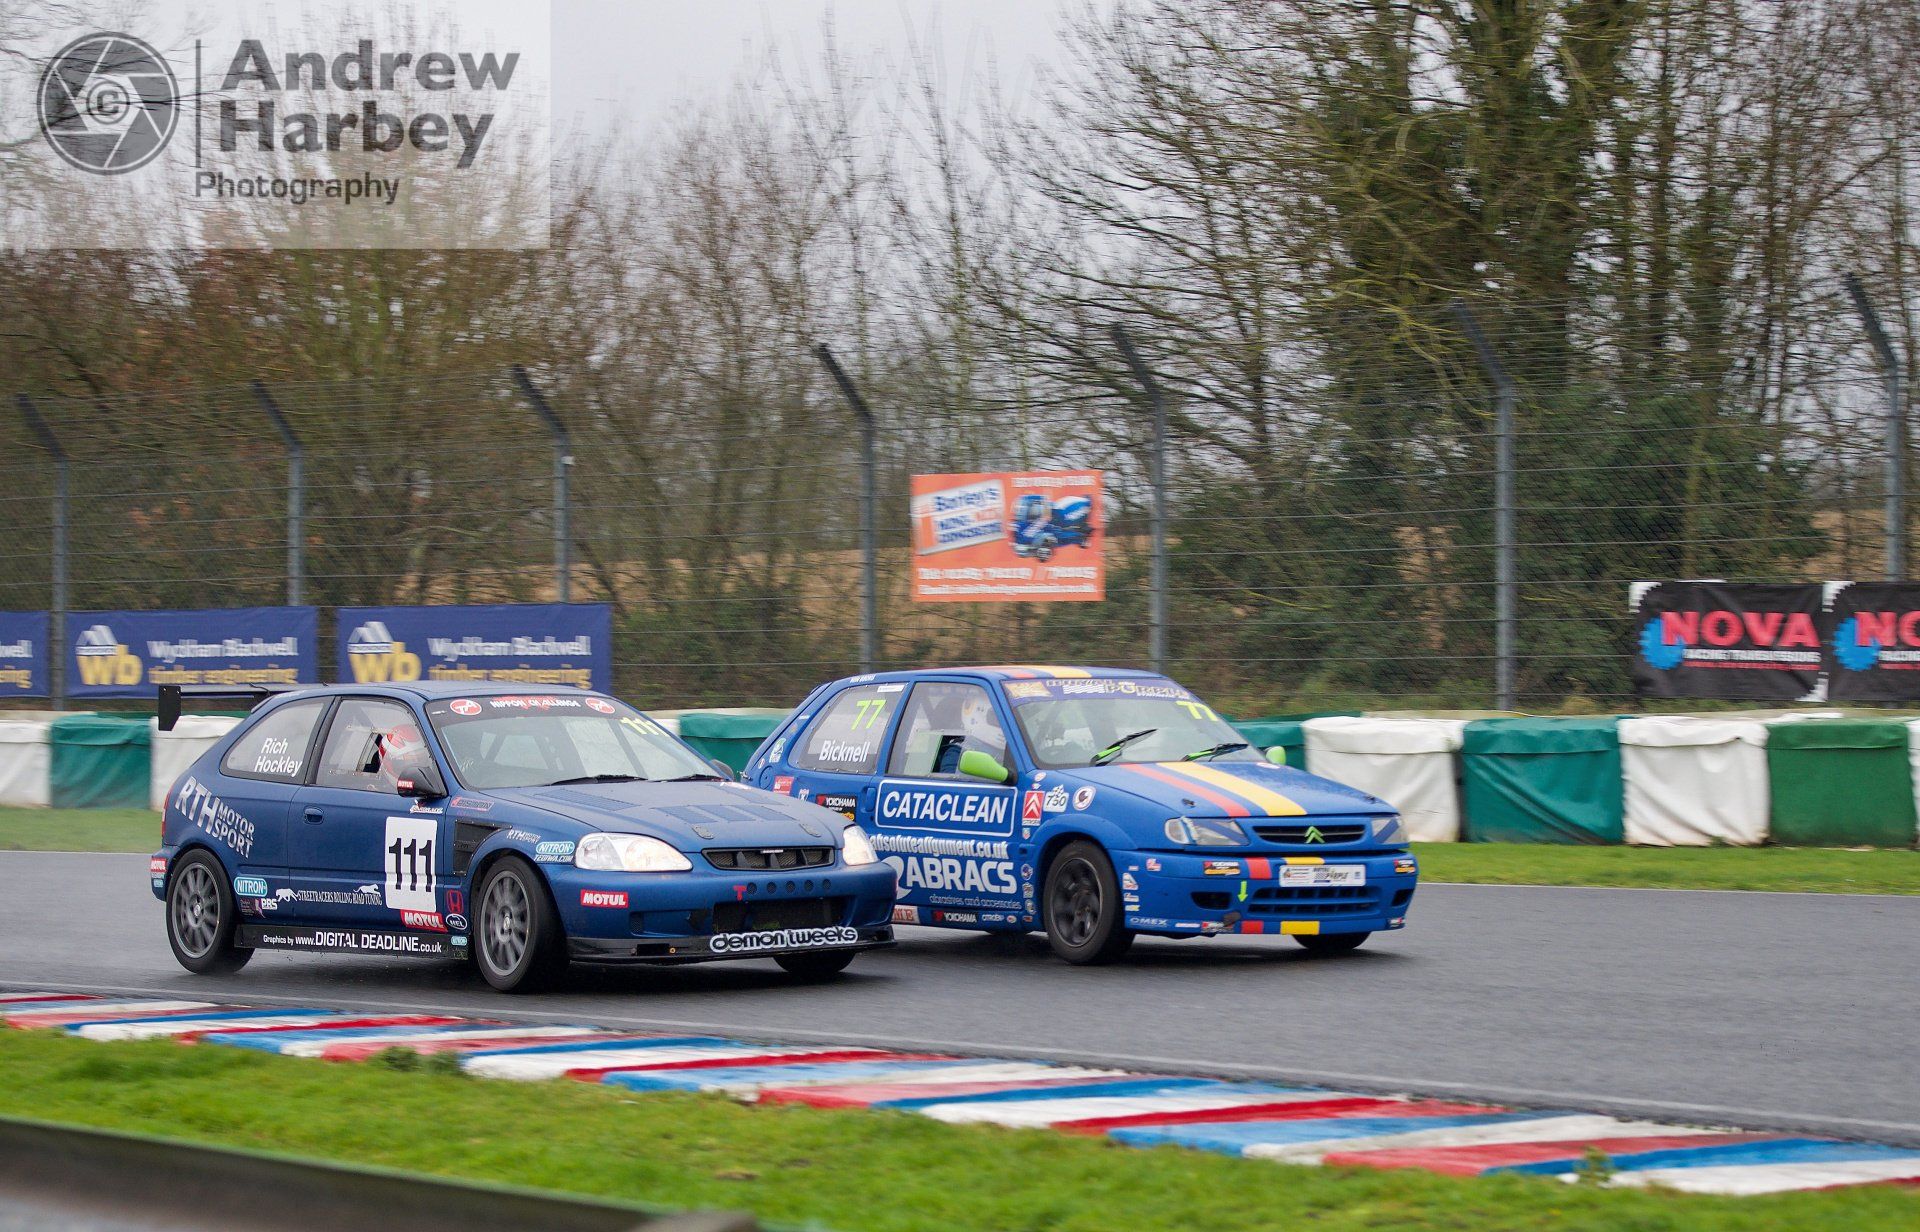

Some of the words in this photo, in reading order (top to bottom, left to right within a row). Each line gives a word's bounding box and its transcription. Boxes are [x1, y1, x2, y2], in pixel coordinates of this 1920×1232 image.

[1660, 610, 1821, 647] NOVA
[490, 699, 527, 708] NIPPON
[1175, 700, 1219, 721] 77
[851, 699, 887, 730] 77
[620, 717, 670, 737] 111
[261, 737, 288, 755] Rich
[818, 740, 870, 763] Bicknell
[254, 755, 303, 778] Hockley
[175, 775, 220, 834] RTH
[826, 797, 856, 807] YOKOHAMA
[883, 791, 1009, 824] CATACLEAN
[217, 802, 255, 841] MOTOR
[211, 818, 253, 859] SPORT
[539, 842, 571, 853] NITRON
[388, 838, 432, 893] 111
[907, 856, 1017, 895] ABRACS
[237, 879, 265, 894] NITRON
[583, 892, 626, 906] MOTUL
[964, 896, 980, 906] and
[404, 912, 444, 928] MOTUL
[944, 912, 977, 923] YOKOHAMA
[1130, 917, 1168, 926] OMEX
[263, 934, 287, 945] Graphics
[287, 936, 294, 946] by
[710, 931, 785, 952] demon
[786, 926, 858, 947] tweeks
